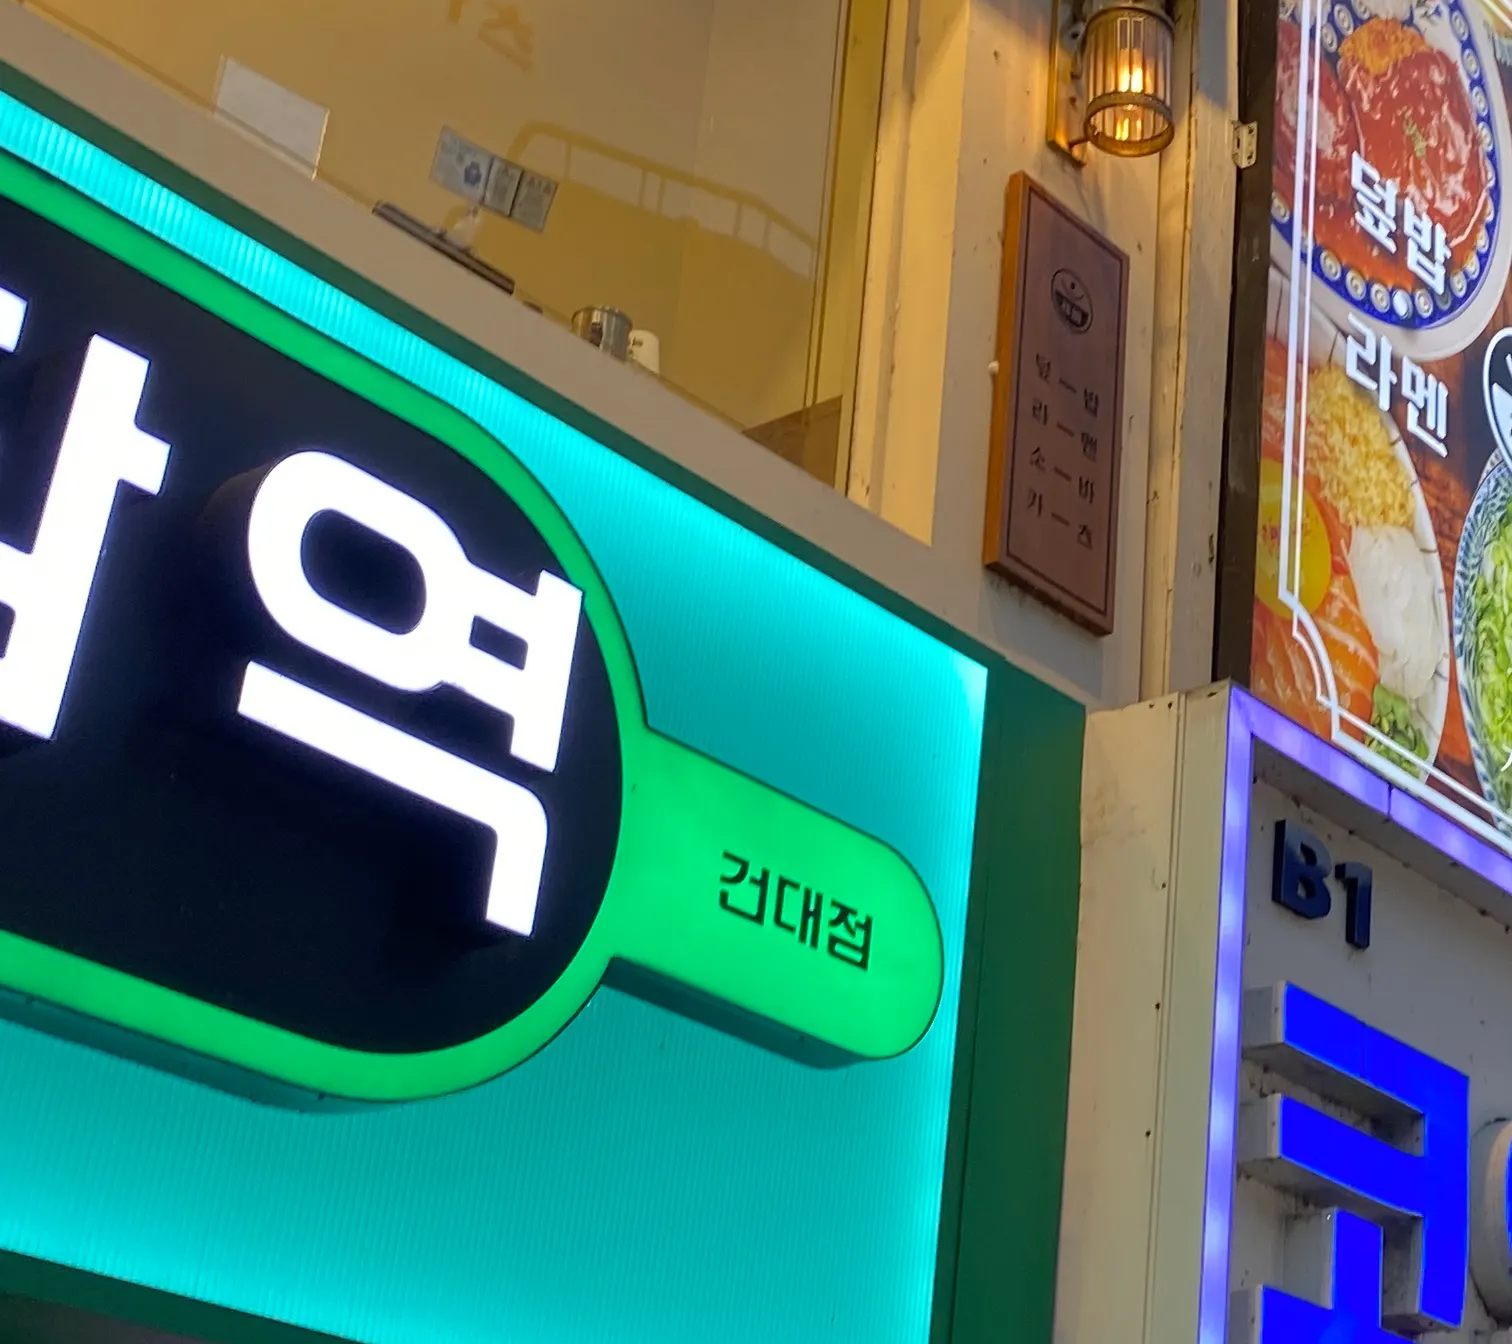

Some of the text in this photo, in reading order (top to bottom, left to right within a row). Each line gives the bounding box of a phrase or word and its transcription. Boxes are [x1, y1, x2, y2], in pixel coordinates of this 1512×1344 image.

[1351, 150, 1452, 296] 덮밥
[1345, 313, 1450, 457] 라멘
[718, 850, 874, 971] 건대점
[1271, 819, 1374, 950] B1
